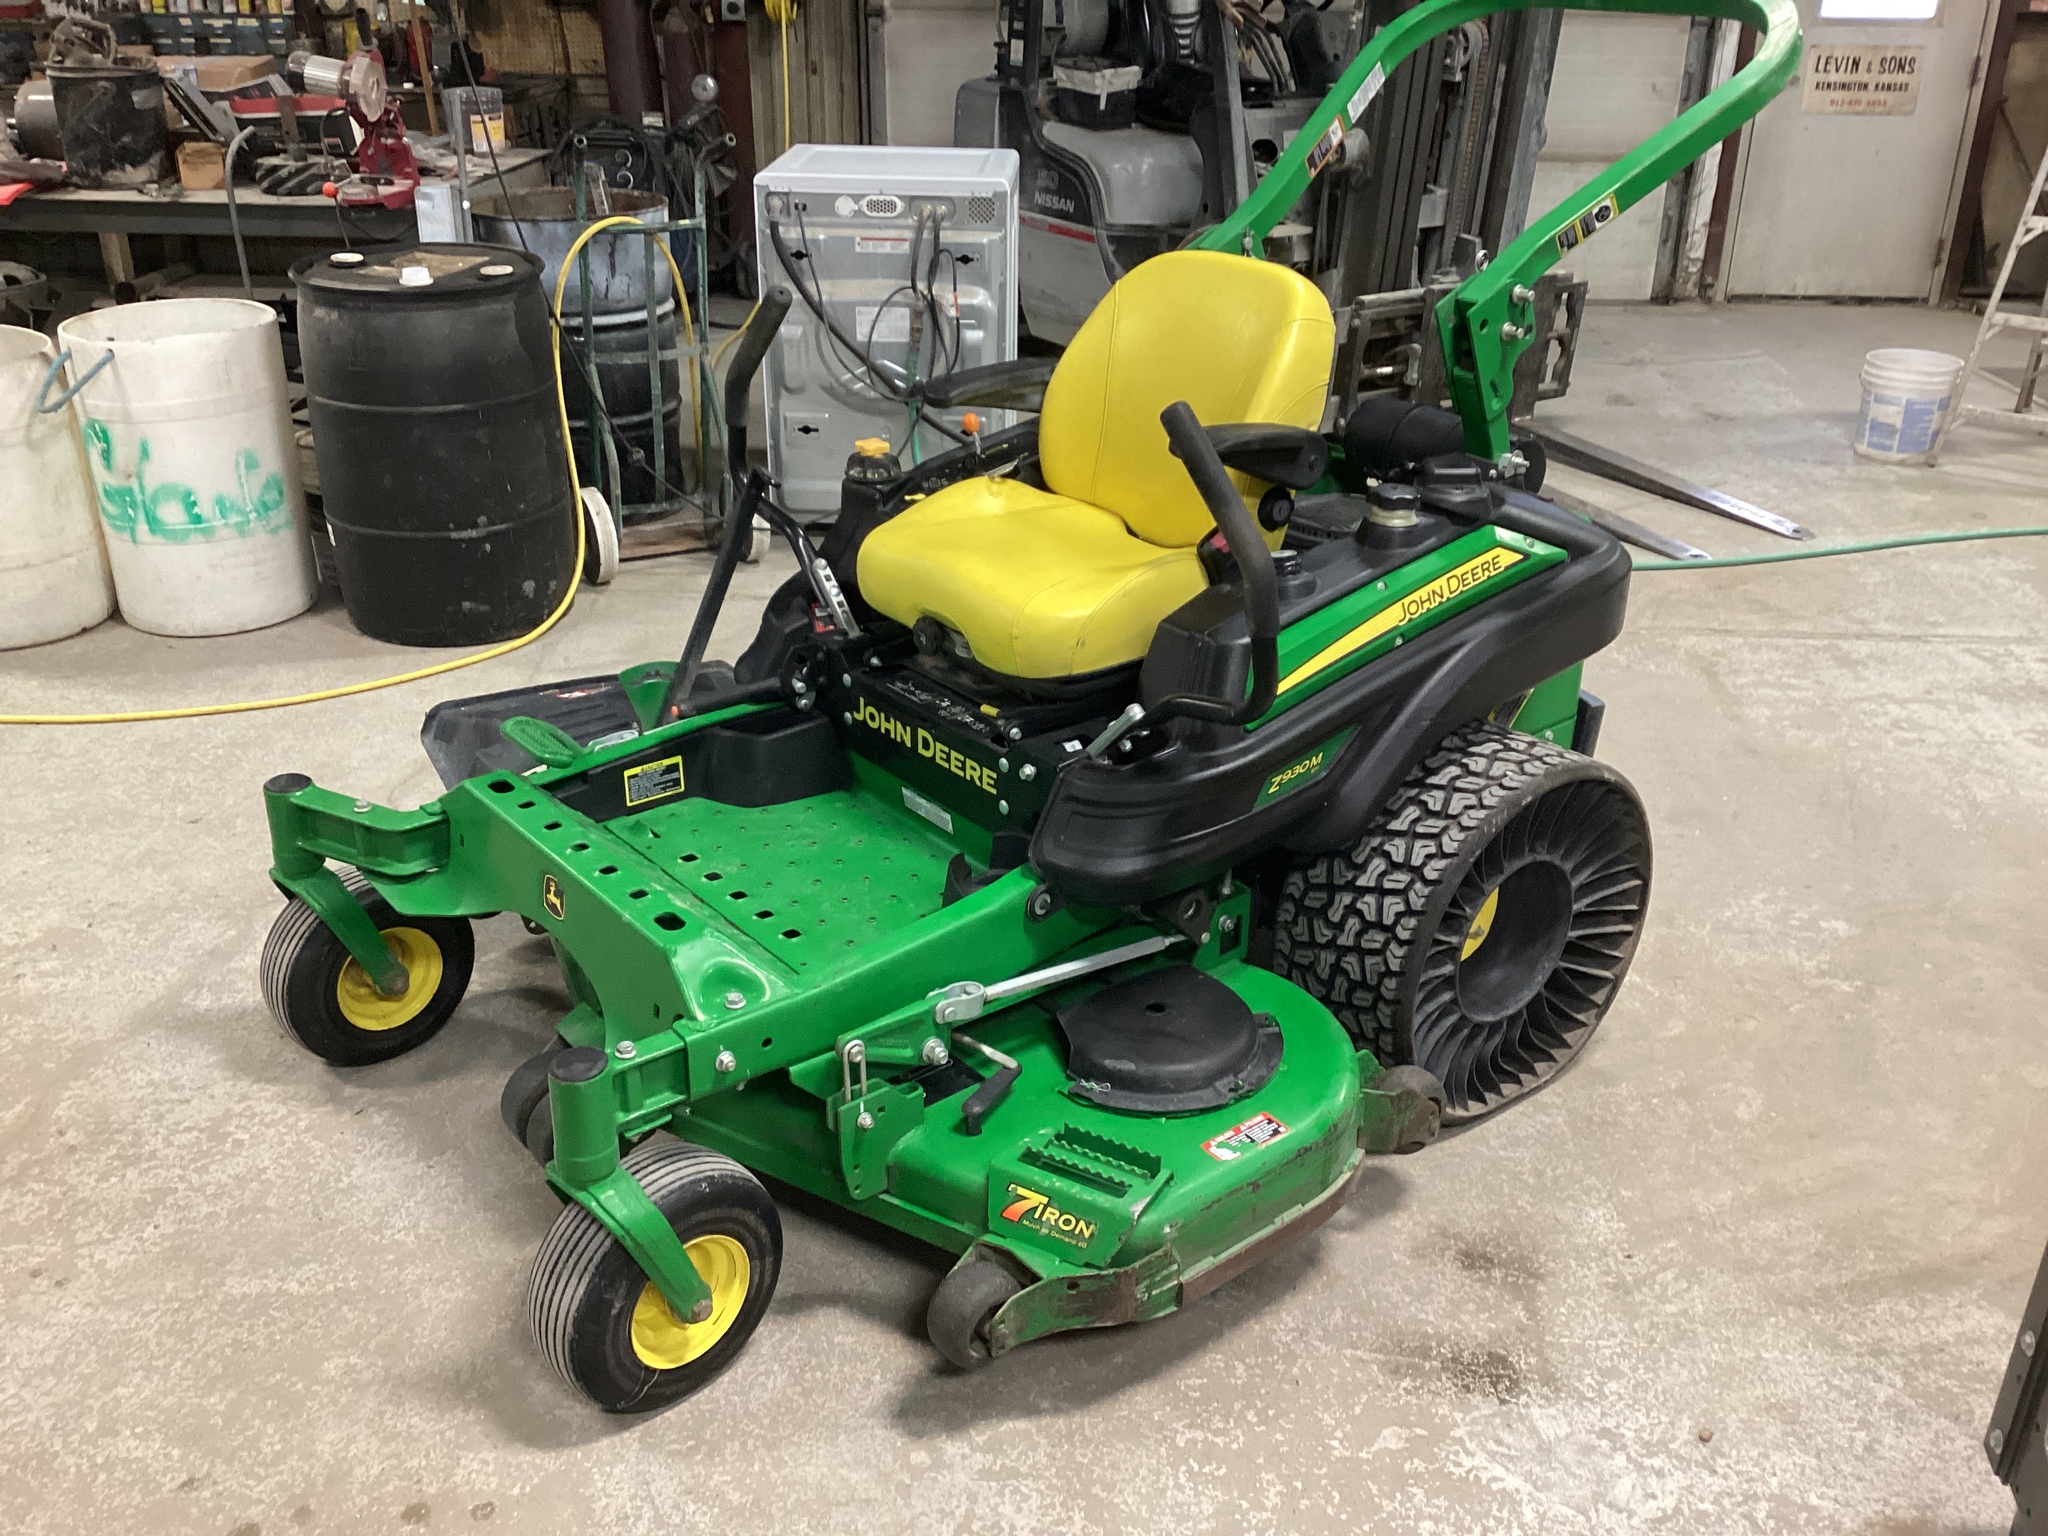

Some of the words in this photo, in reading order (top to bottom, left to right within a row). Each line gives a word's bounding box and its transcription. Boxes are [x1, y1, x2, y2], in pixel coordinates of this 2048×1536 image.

[1814, 54, 1861, 75] LEVIN
[1866, 60, 1873, 74] &
[1878, 55, 1917, 75] SONS
[1874, 82, 1910, 93] KANSAS
[1034, 190, 1075, 214] NISSAN
[1398, 584, 1445, 624] JOHN
[1446, 554, 1503, 596] DEERE
[853, 696, 912, 749] JOHN
[917, 726, 998, 796] DEERE
[1267, 751, 1324, 795] Z930M
